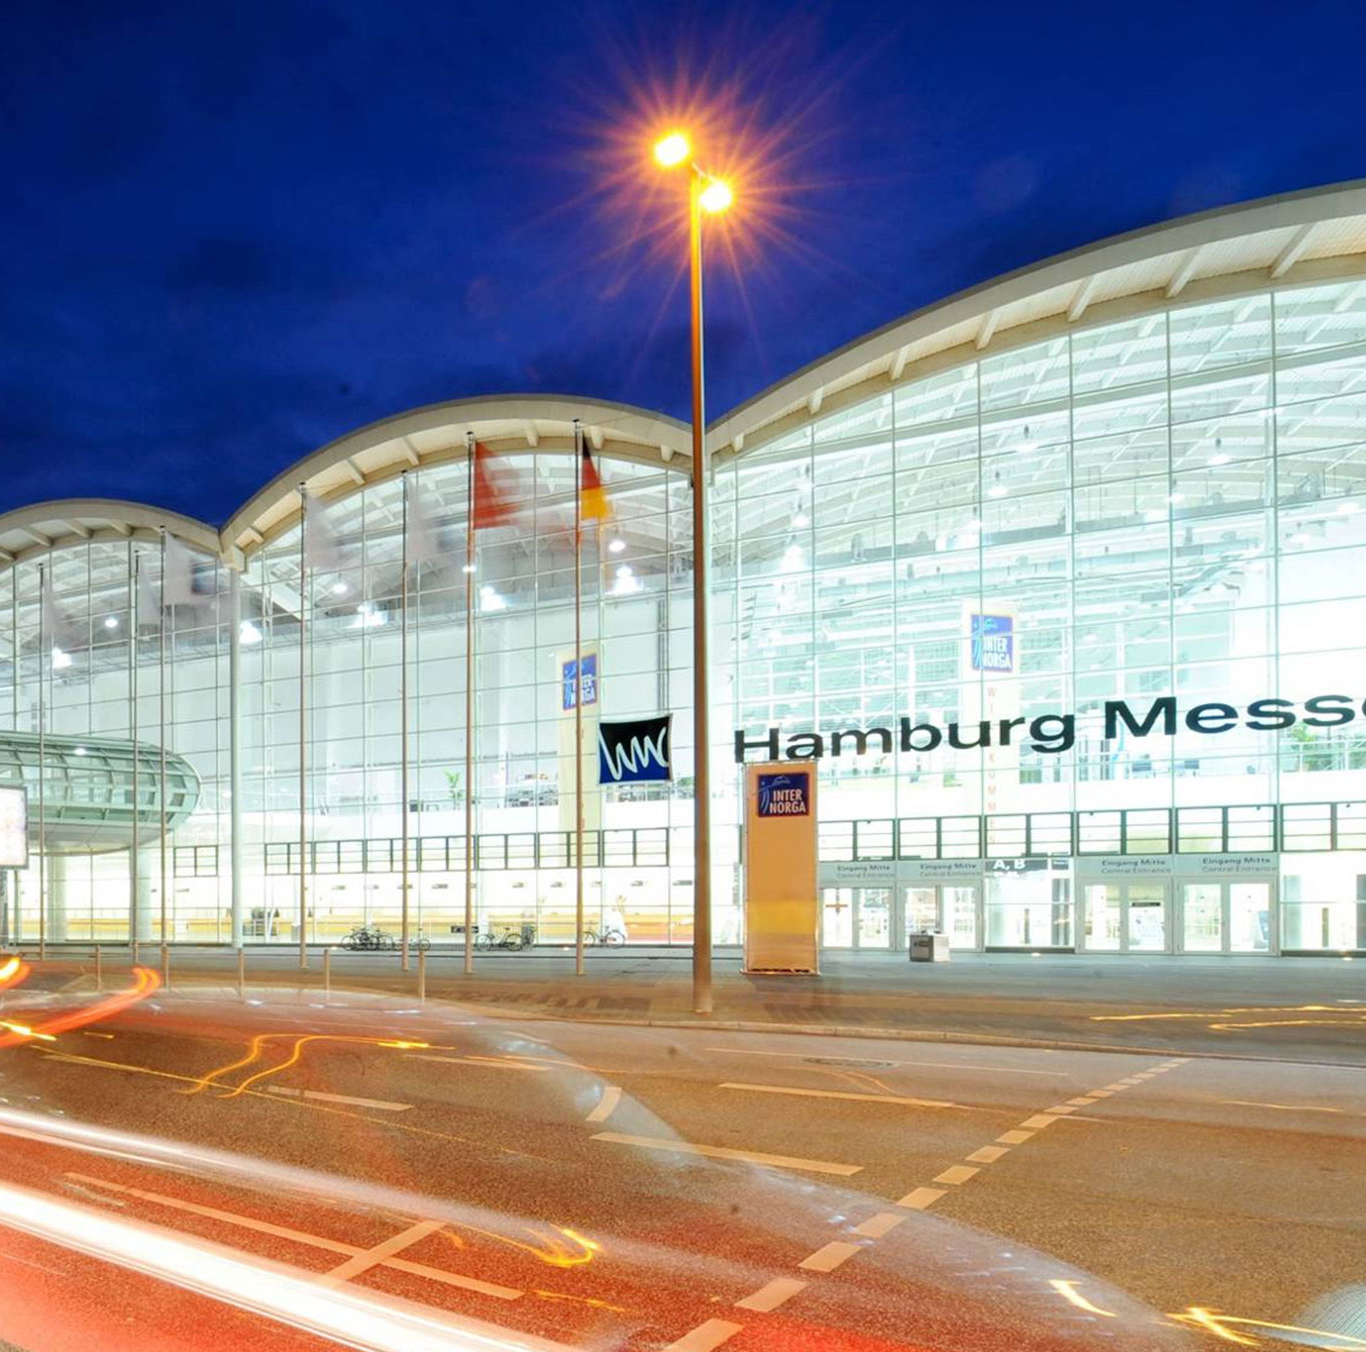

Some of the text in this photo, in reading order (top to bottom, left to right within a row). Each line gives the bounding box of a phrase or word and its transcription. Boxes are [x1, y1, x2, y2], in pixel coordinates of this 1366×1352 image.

[734, 694, 1366, 763] Hamburg Mess
[773, 789, 802, 802] INTER
[769, 801, 806, 814] NORGA
[1014, 859, 1026, 869] B
[1203, 858, 1241, 866] Eingang
